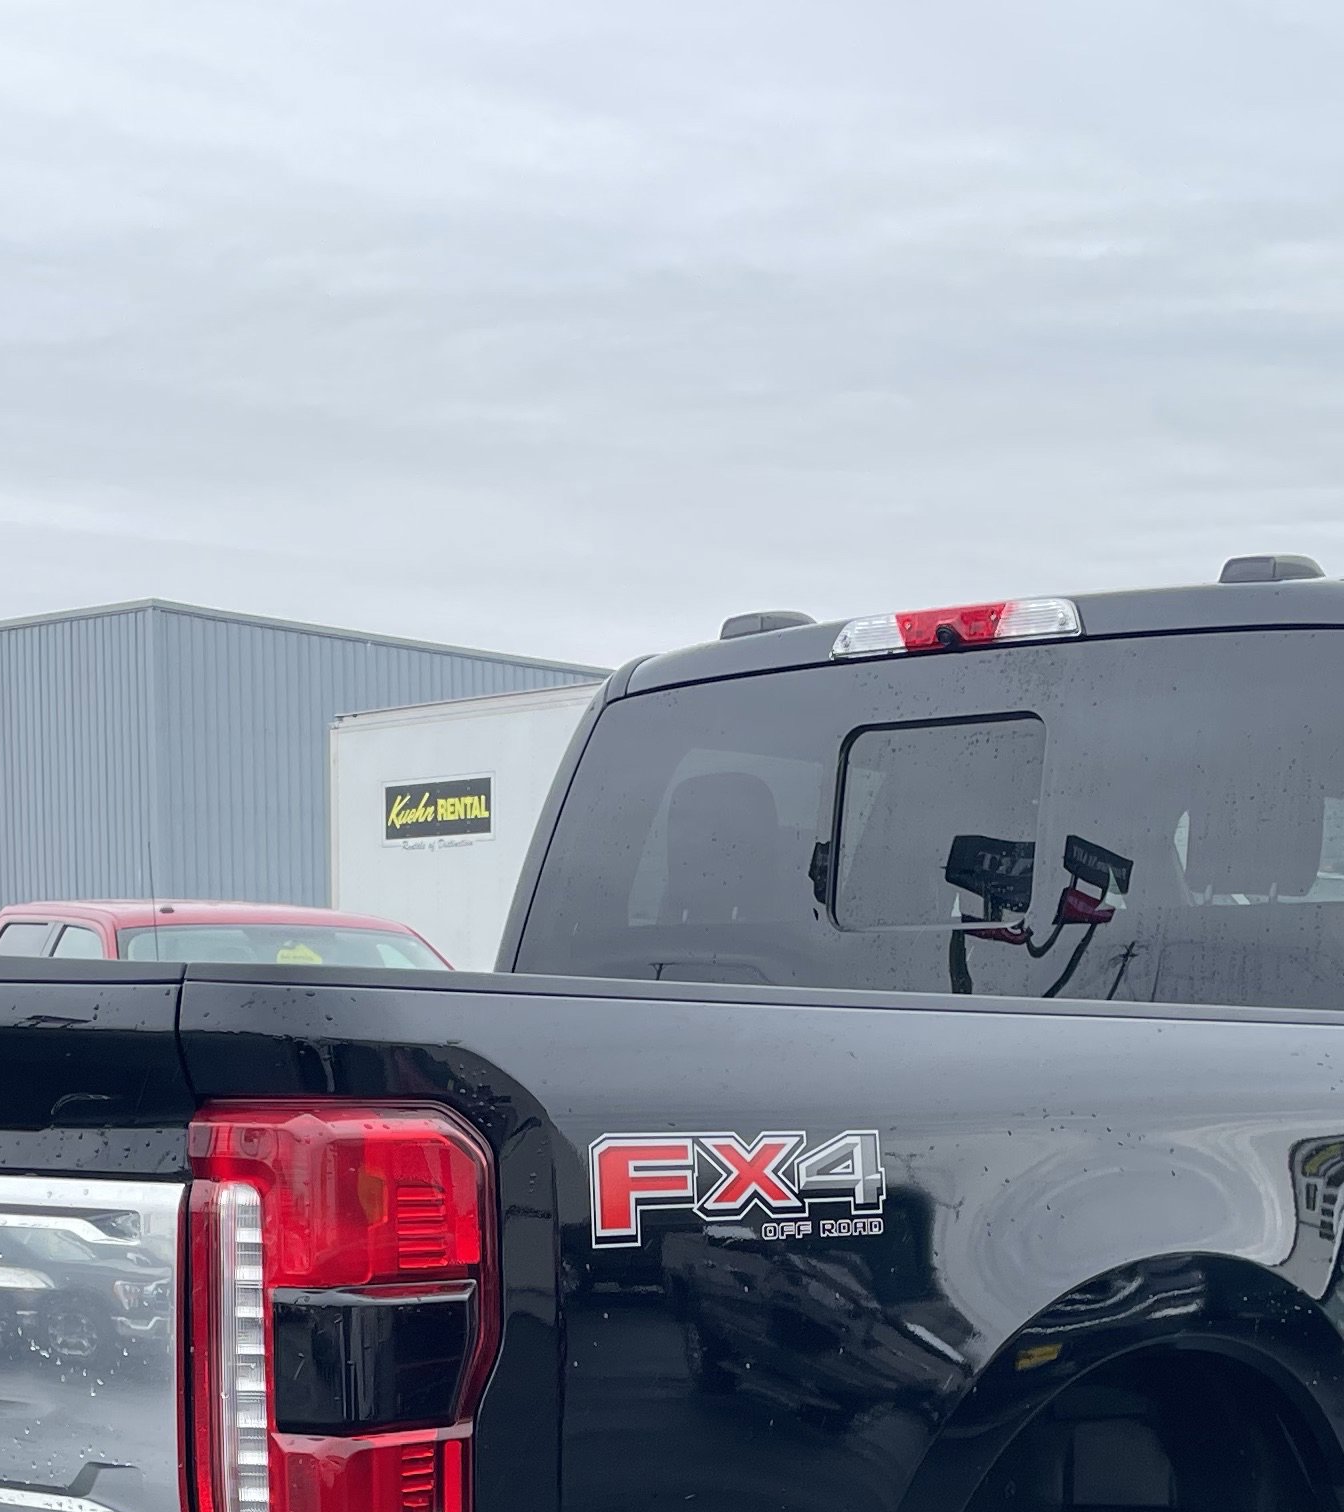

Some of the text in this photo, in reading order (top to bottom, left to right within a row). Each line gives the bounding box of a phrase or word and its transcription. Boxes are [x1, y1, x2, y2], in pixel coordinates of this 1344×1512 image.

[388, 792, 490, 829] Kuehn RENTAL
[589, 1130, 886, 1249] FX4
[761, 1217, 884, 1241] OFF ROAD
